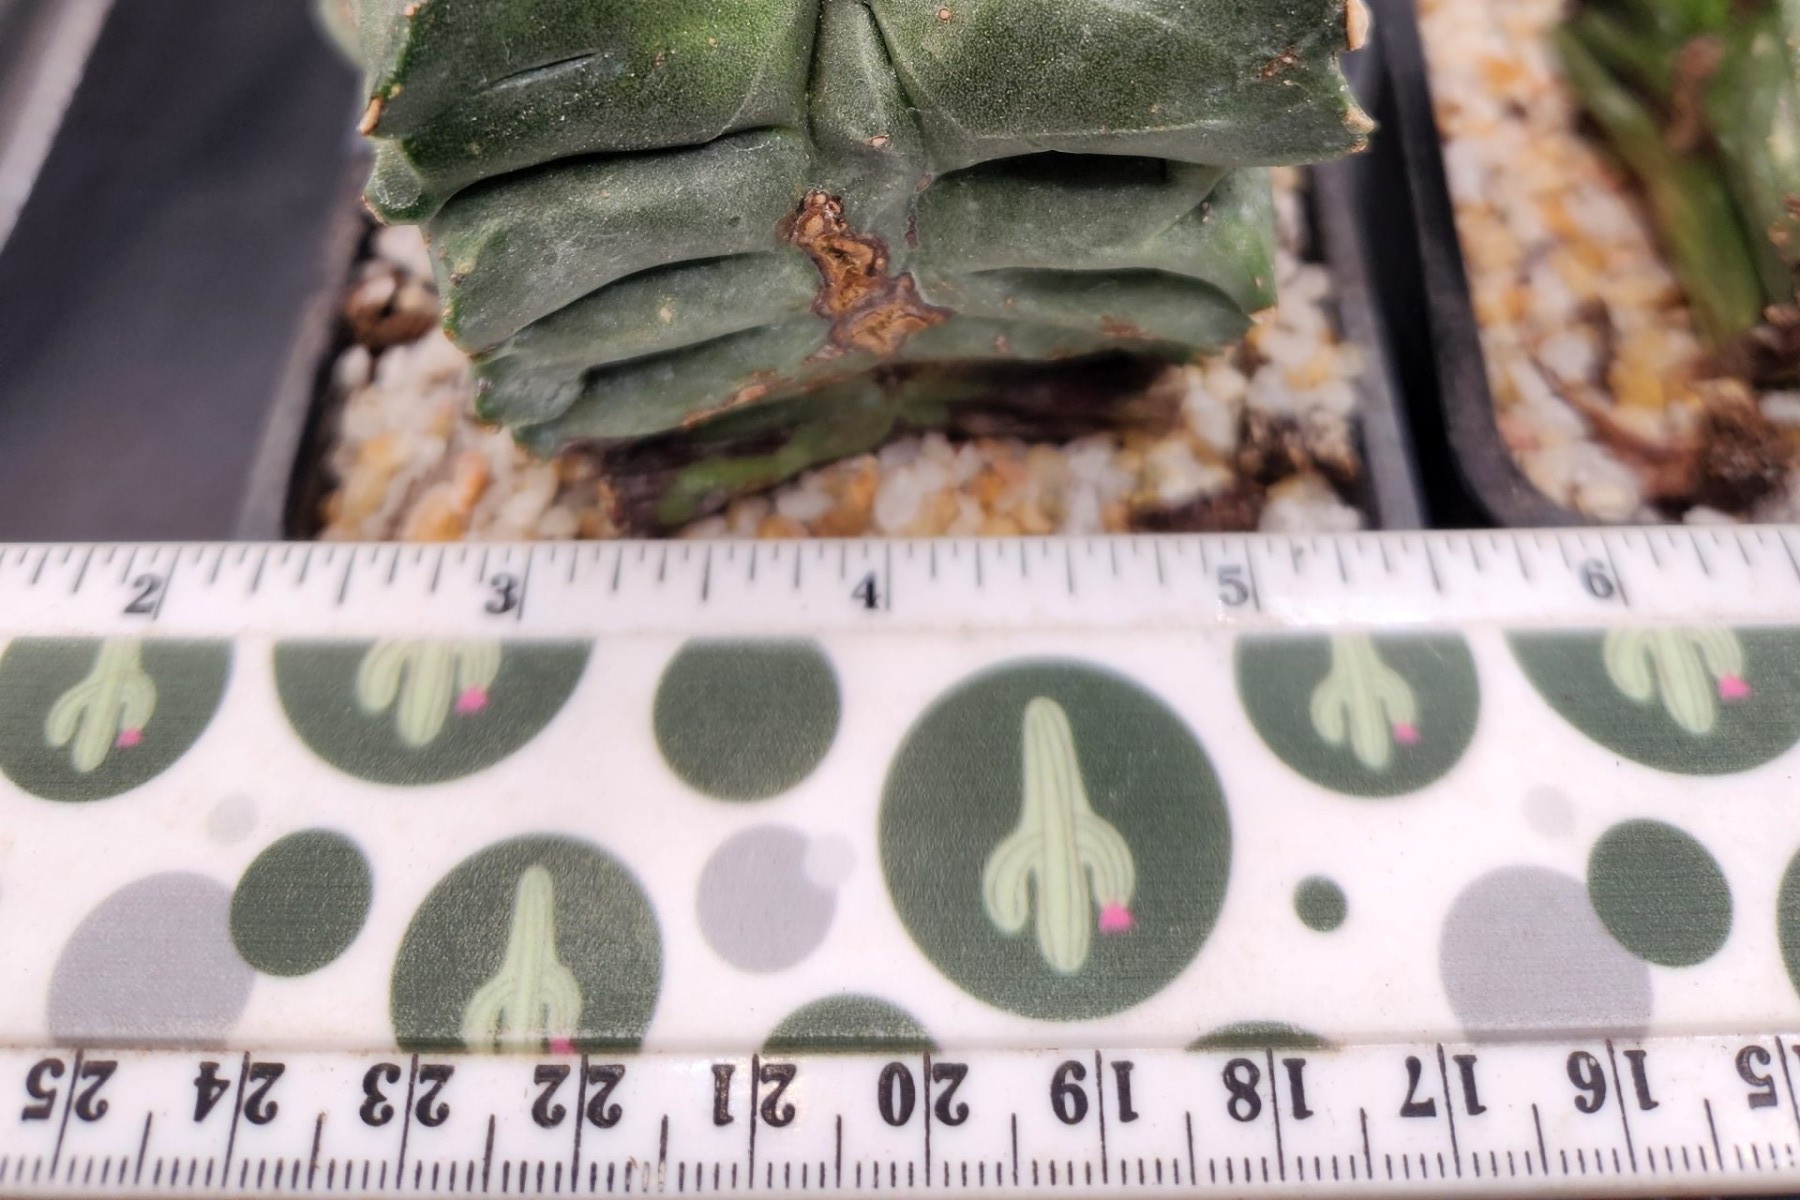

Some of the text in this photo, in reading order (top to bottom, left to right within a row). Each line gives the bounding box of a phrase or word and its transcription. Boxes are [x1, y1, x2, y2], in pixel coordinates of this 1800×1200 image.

[122, 560, 1614, 616] 2 3 4 5 6
[21, 1045, 1800, 1128] 5 16 17 18 19 20 21 22 23 24 25
